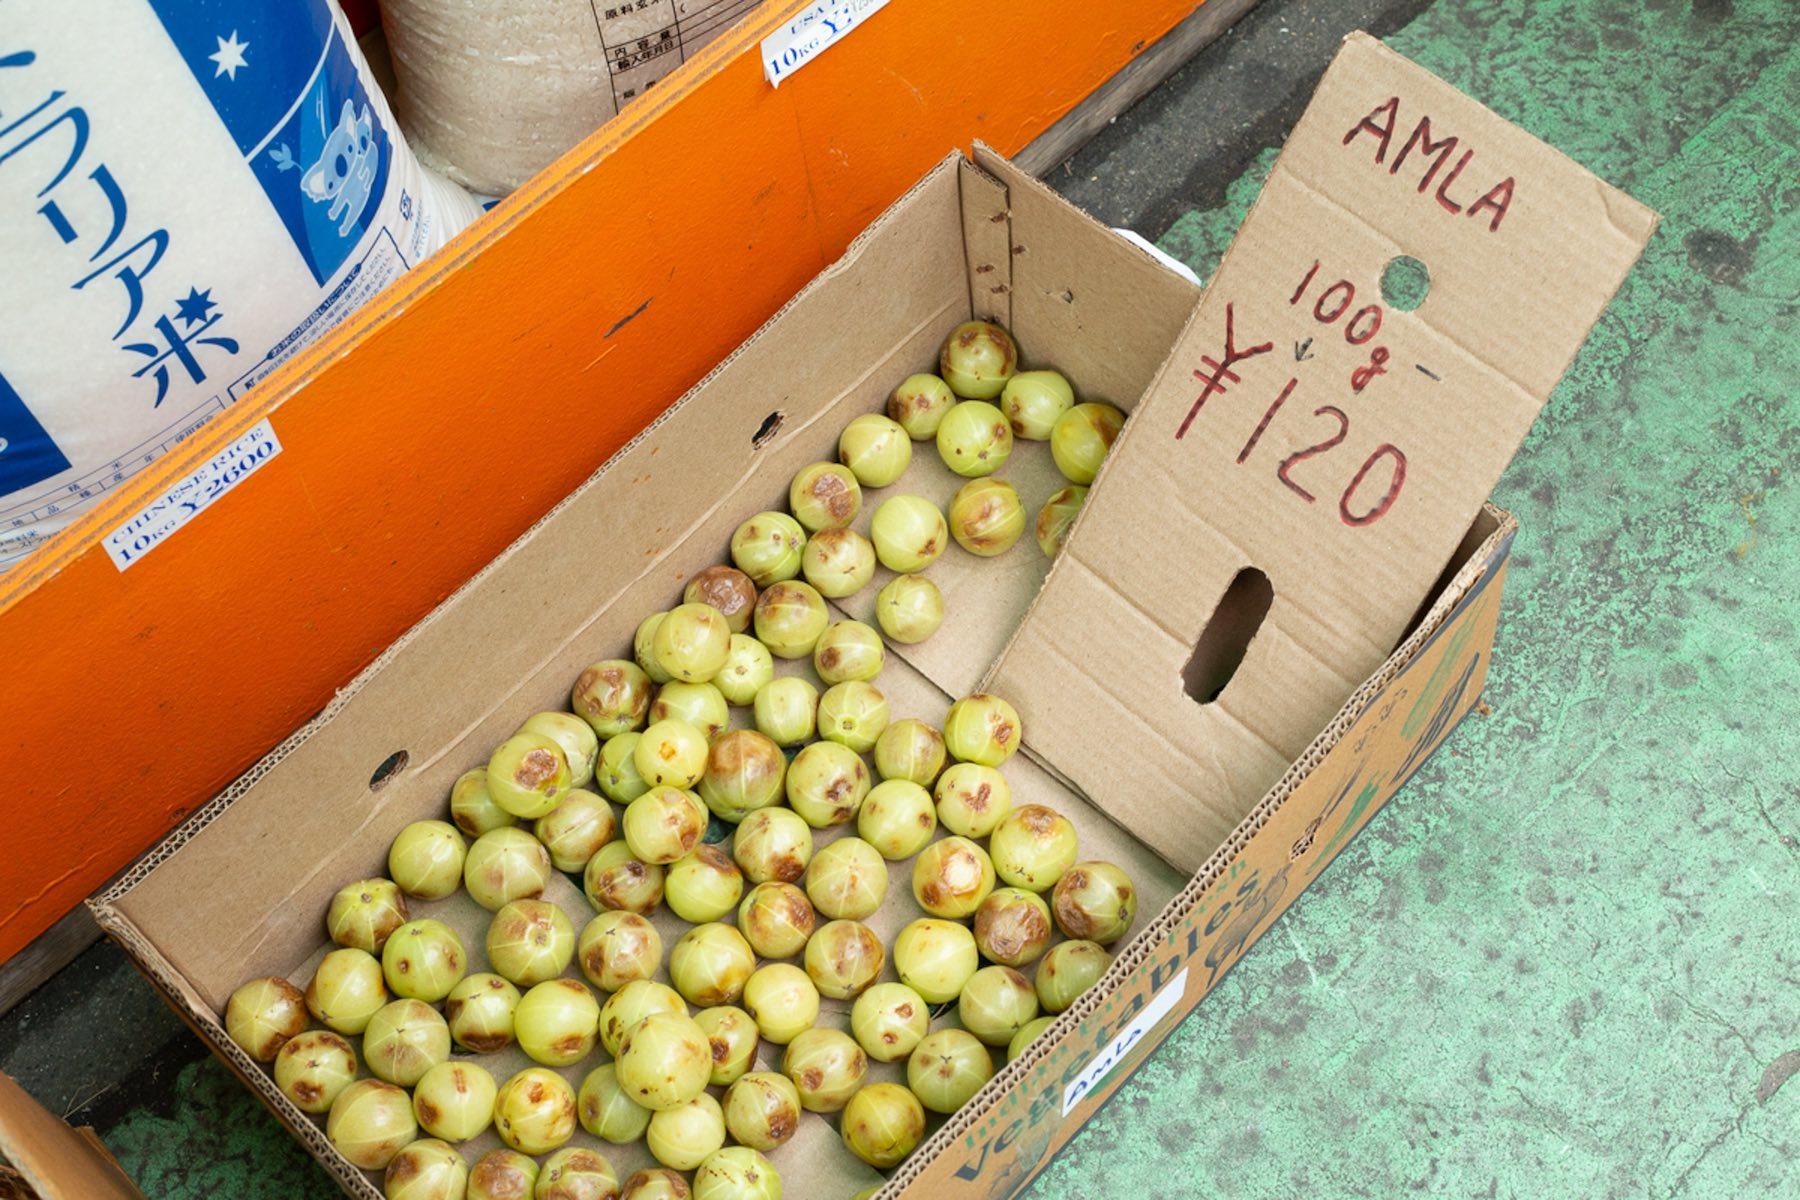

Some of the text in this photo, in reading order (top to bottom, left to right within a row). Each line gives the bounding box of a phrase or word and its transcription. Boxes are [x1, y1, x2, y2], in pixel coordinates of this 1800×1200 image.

[1343, 97, 1515, 232] AMLA
[1290, 260, 1391, 394] 100g
[179, 441, 273, 511] Y2600
[1175, 302, 1408, 527] ¥120
[112, 469, 208, 545] CHINESE
[211, 427, 264, 472] RICE
[954, 868, 1259, 1183] Vegetables
